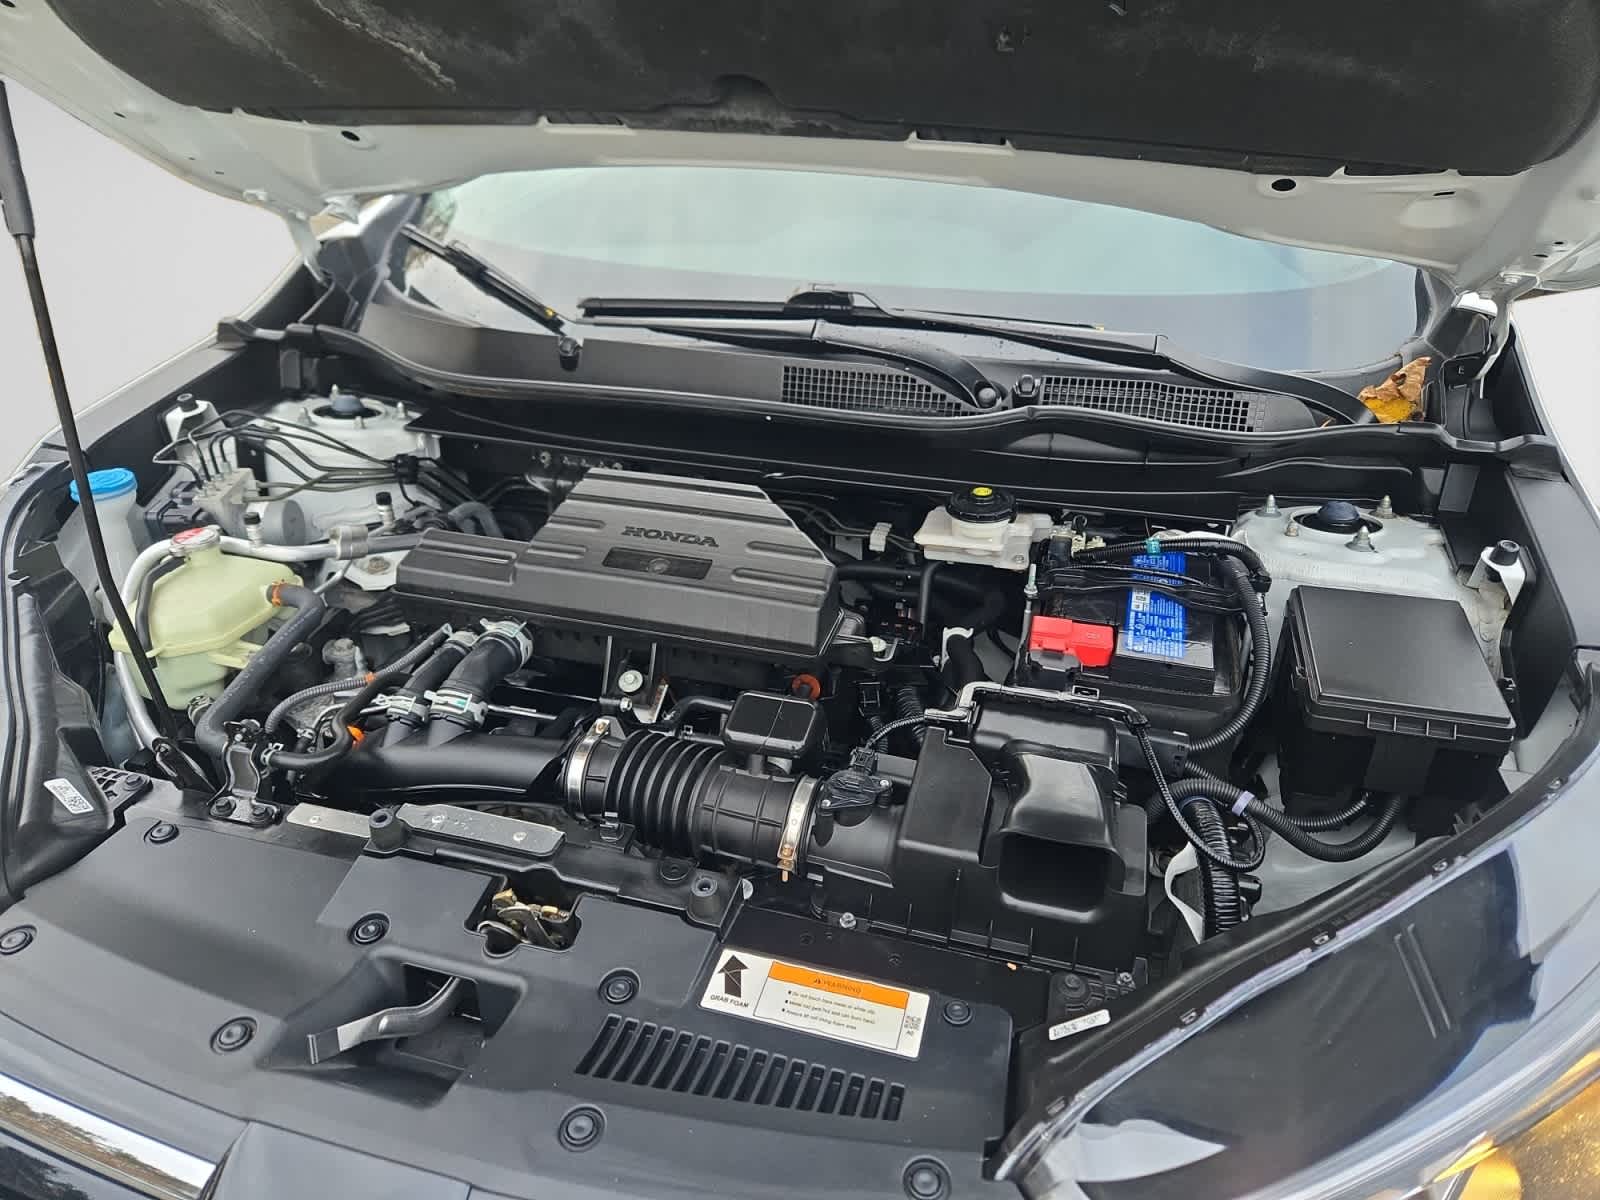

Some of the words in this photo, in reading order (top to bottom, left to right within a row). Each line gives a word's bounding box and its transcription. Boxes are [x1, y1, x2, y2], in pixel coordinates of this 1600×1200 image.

[621, 525, 719, 548] HONDA
[710, 994, 729, 1003] GRAB
[729, 999, 749, 1008] FOAM
